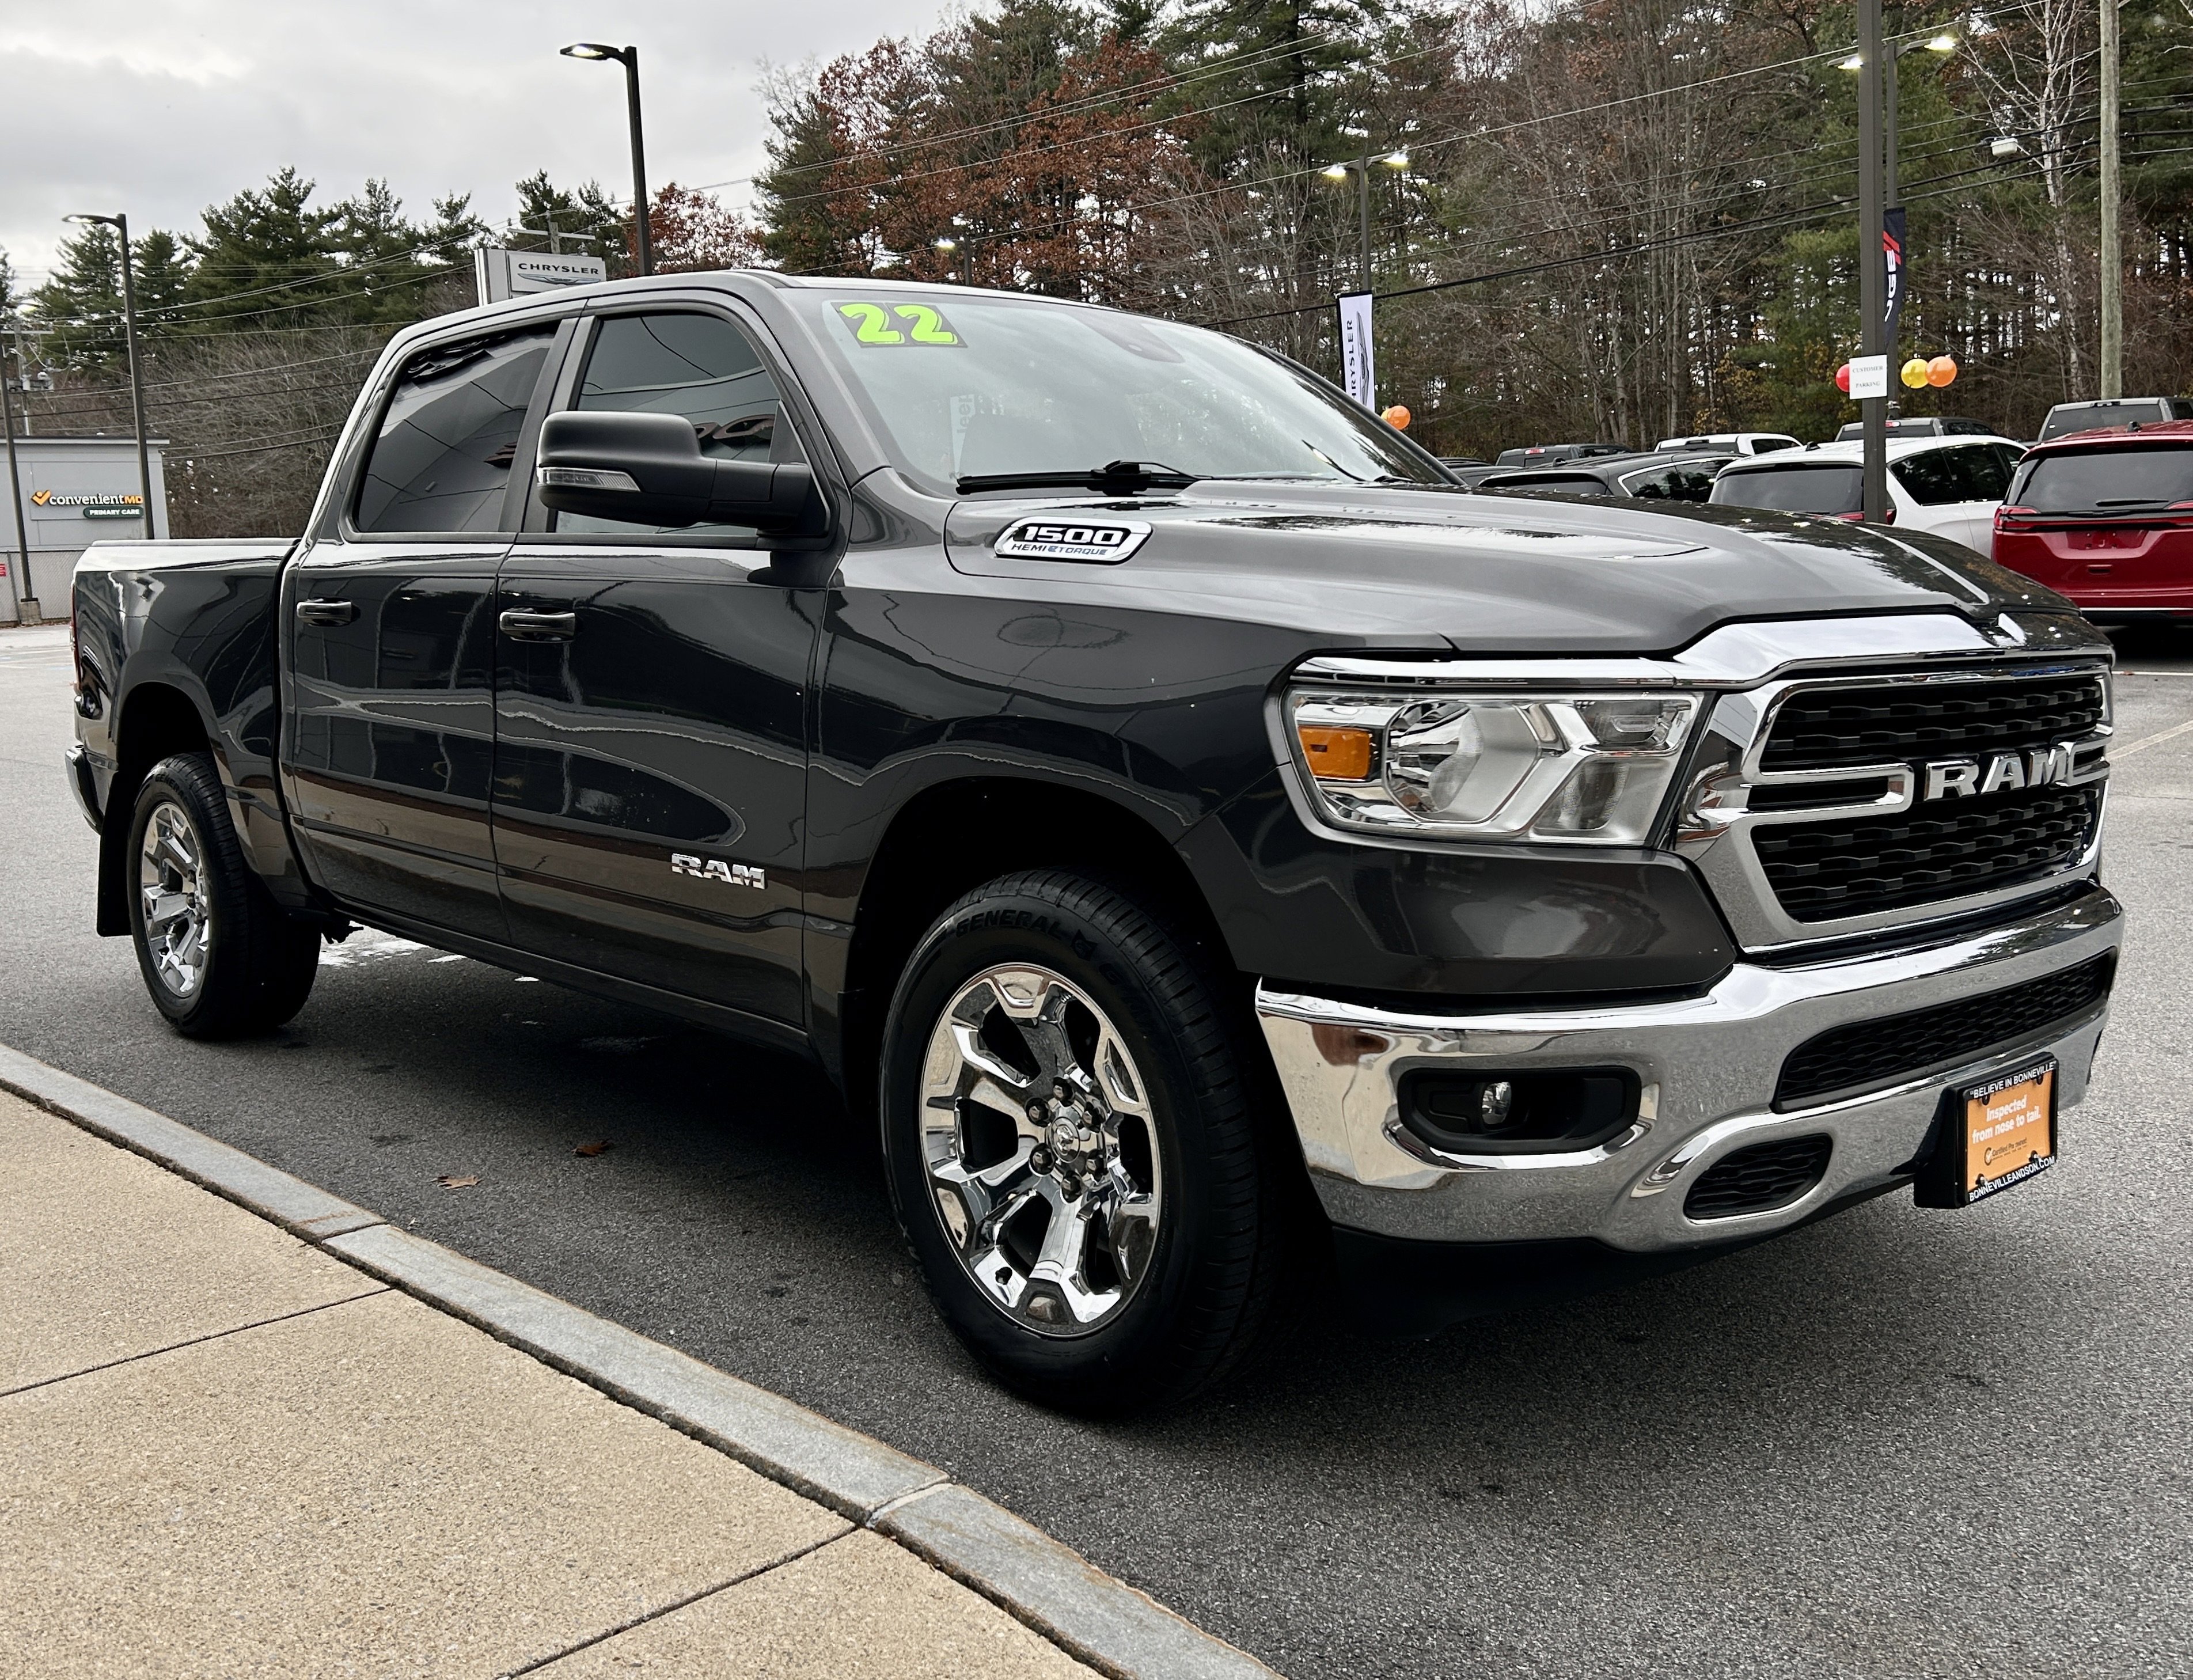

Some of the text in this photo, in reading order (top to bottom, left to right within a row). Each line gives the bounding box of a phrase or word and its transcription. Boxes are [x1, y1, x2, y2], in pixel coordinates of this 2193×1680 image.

[518, 263, 599, 275] CHRYSLER
[839, 303, 958, 344] 22
[49, 492, 143, 506] convenientMD
[1011, 543, 1047, 552] HEMI
[1024, 526, 1124, 545] 1500
[1923, 748, 2069, 801] RAM
[671, 853, 766, 889] RAM
[2005, 1077, 2013, 1088] IN
[1986, 1094, 2027, 1122] Inspected
[1972, 1127, 1993, 1144] from
[1994, 1119, 2015, 1136] nose
[2016, 1114, 2025, 1128] to
[1969, 1155, 2055, 1202] BONNEVILLEANDSON.COM
